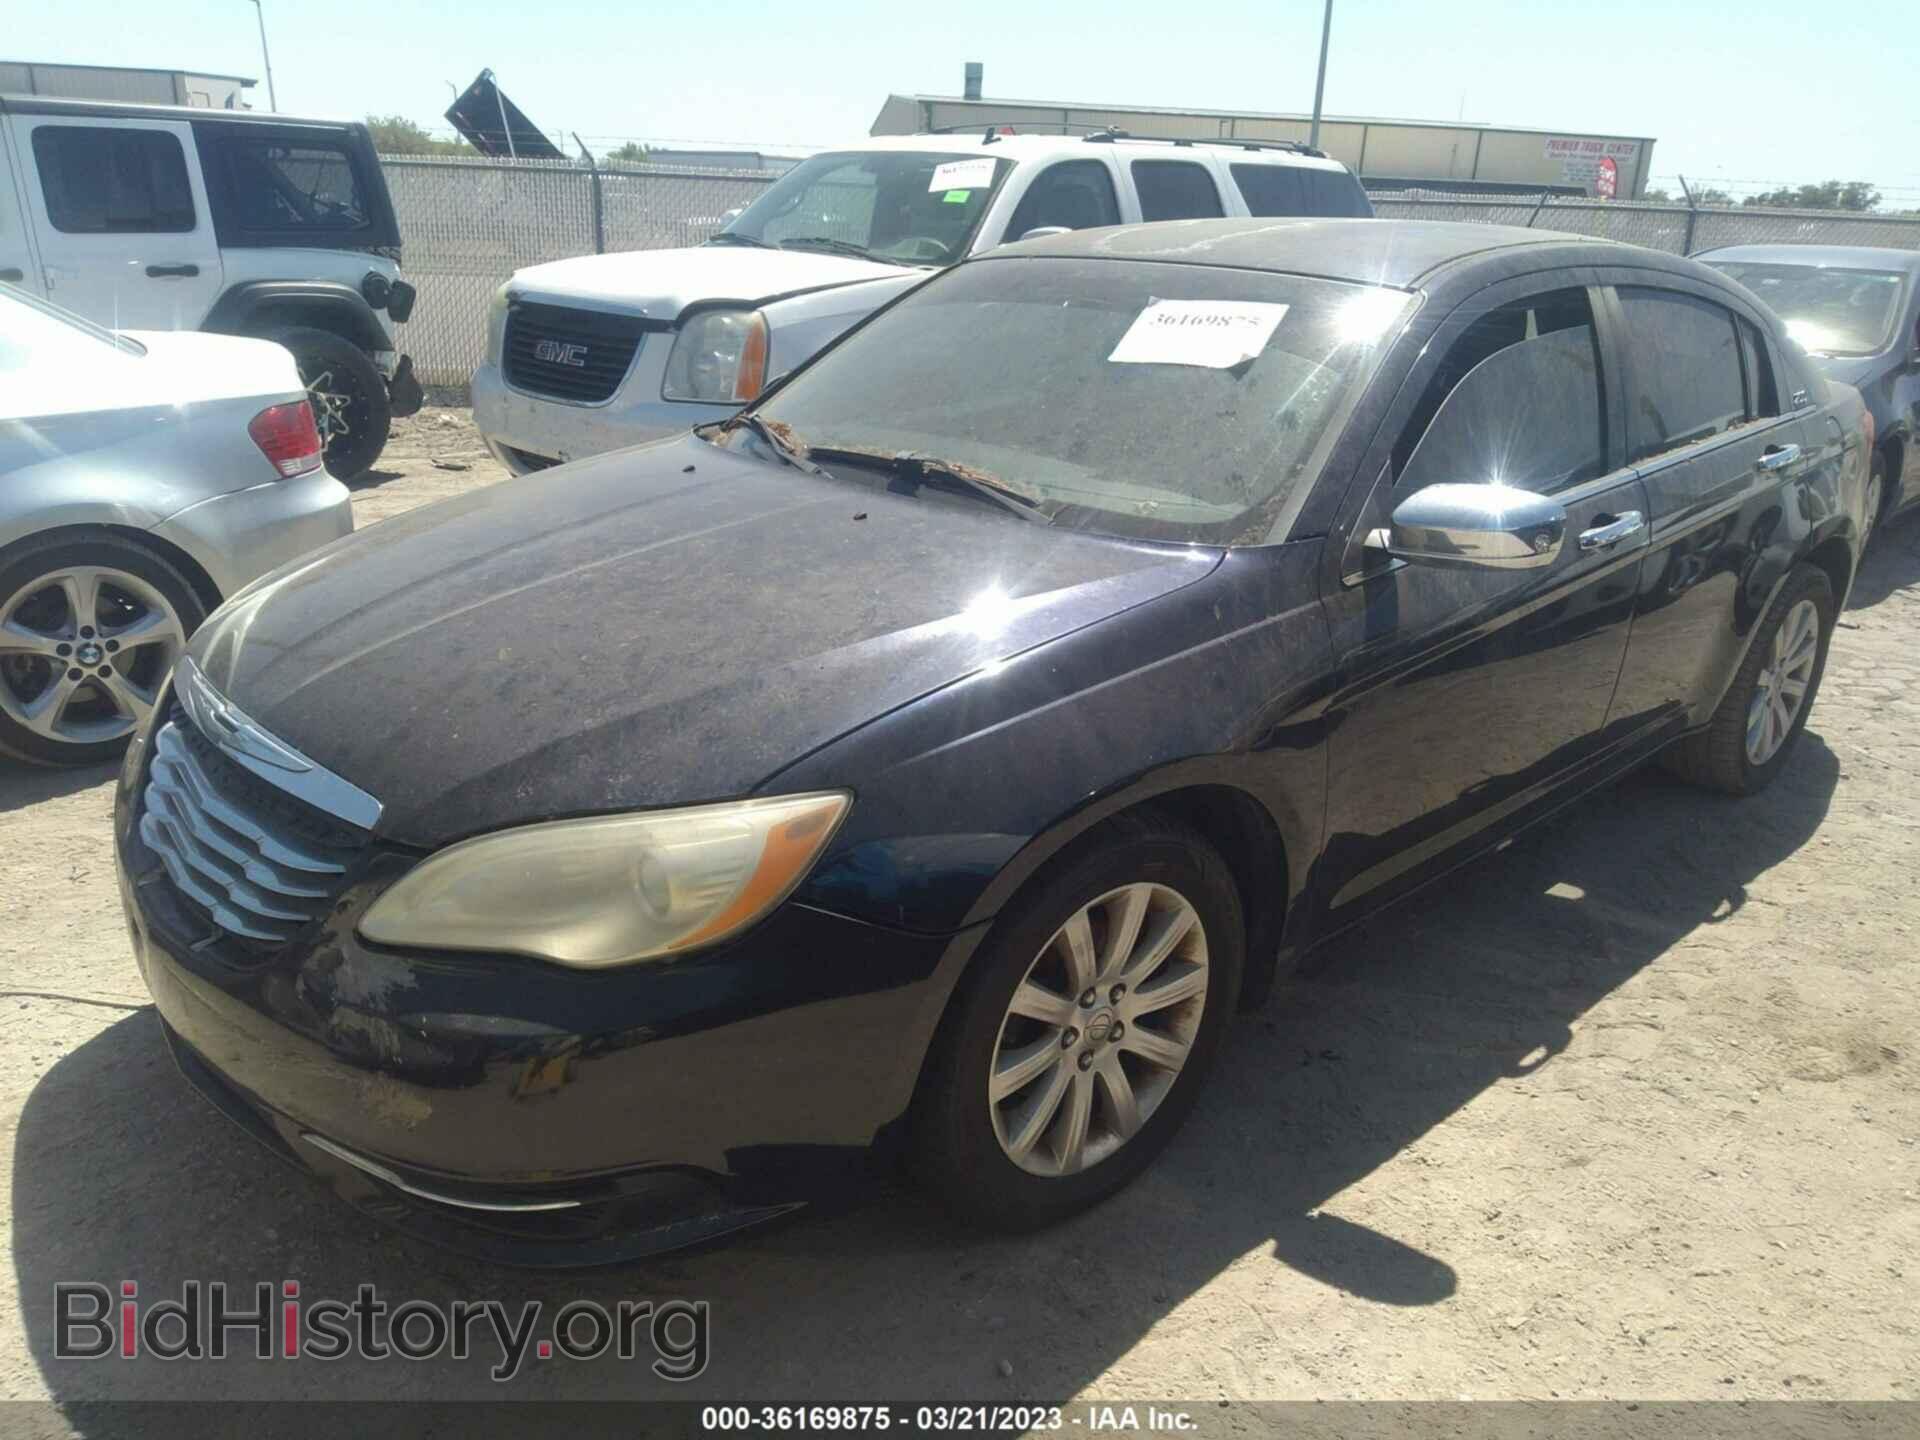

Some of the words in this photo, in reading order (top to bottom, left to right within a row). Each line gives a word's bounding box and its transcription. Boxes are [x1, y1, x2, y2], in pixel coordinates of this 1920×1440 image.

[1580, 141, 1604, 153] TRUCK
[1606, 143, 1634, 155] CENTER
[535, 339, 588, 367] GMC
